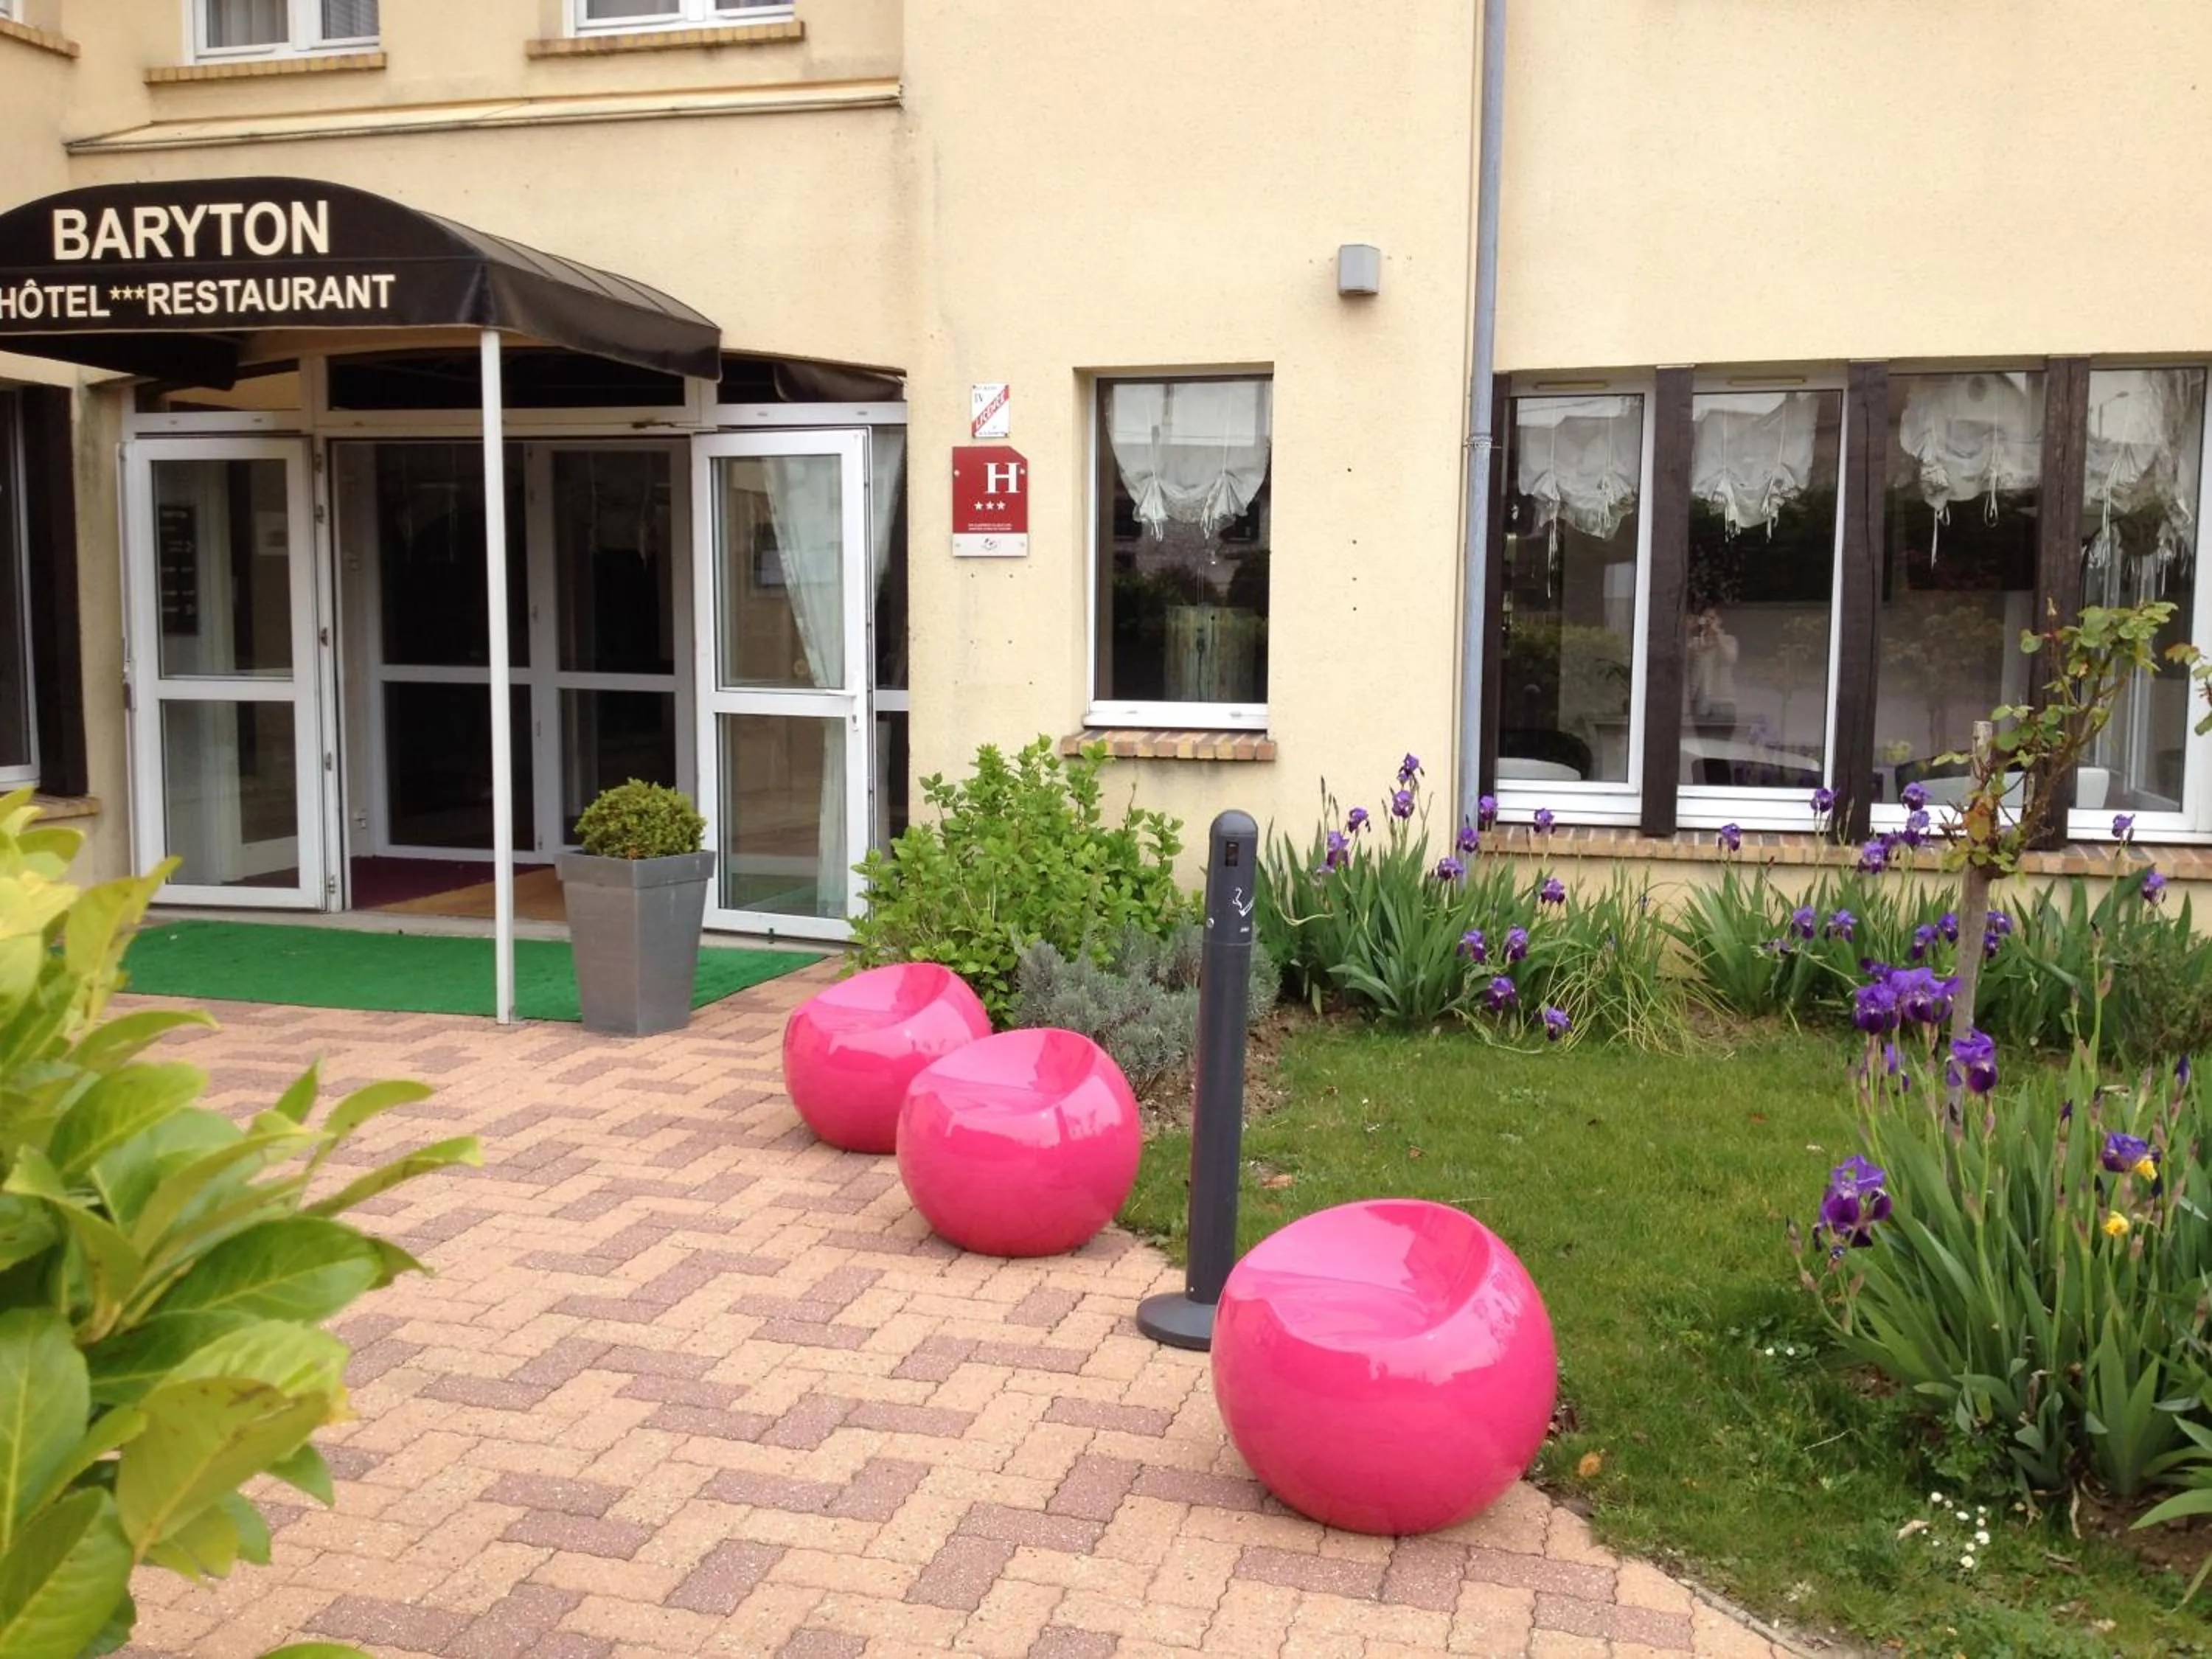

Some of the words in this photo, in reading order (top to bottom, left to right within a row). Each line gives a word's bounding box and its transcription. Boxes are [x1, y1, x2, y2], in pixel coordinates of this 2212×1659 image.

[53, 200, 330, 260] BARYTON
[0, 278, 111, 319] HÔTEL
[147, 274, 395, 316] RESTAURANT
[984, 462, 1021, 494] H
